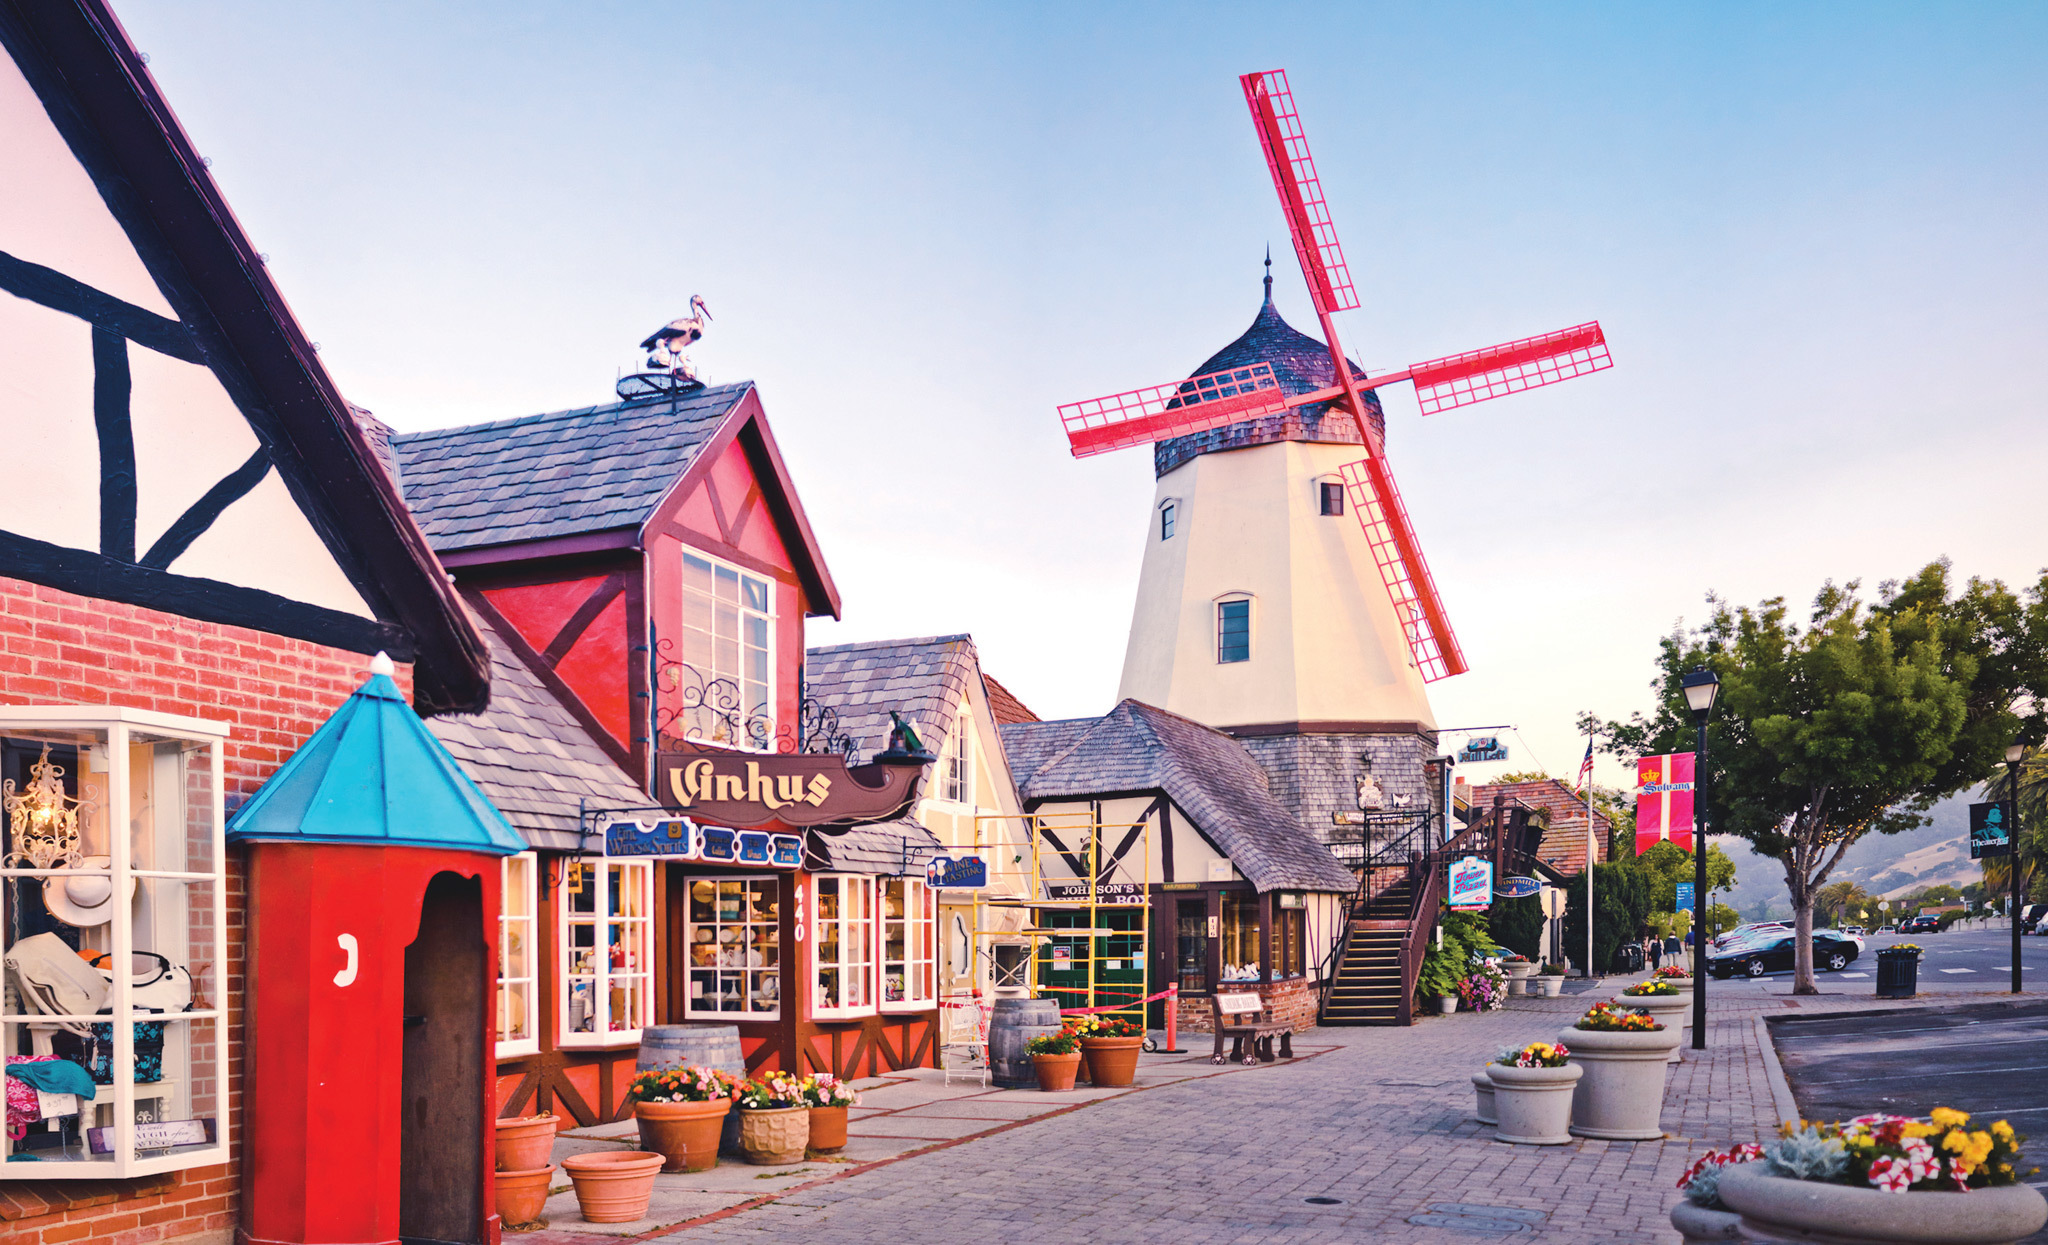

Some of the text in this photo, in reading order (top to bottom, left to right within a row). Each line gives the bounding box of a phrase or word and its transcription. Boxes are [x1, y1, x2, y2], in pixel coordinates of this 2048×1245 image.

[1459, 749, 1506, 762] Mill Loft
[669, 759, 832, 810] Vinhus
[1642, 781, 1691, 795] Solvang
[608, 837, 643, 855] Wines
[651, 835, 688, 856] Spirits
[944, 858, 971, 873] WINE
[945, 866, 983, 883] TASTING
[1455, 870, 1485, 883] Tower
[1454, 880, 1487, 895] Pizza
[1502, 879, 1536, 887] INDMILL
[794, 884, 805, 942] 440
